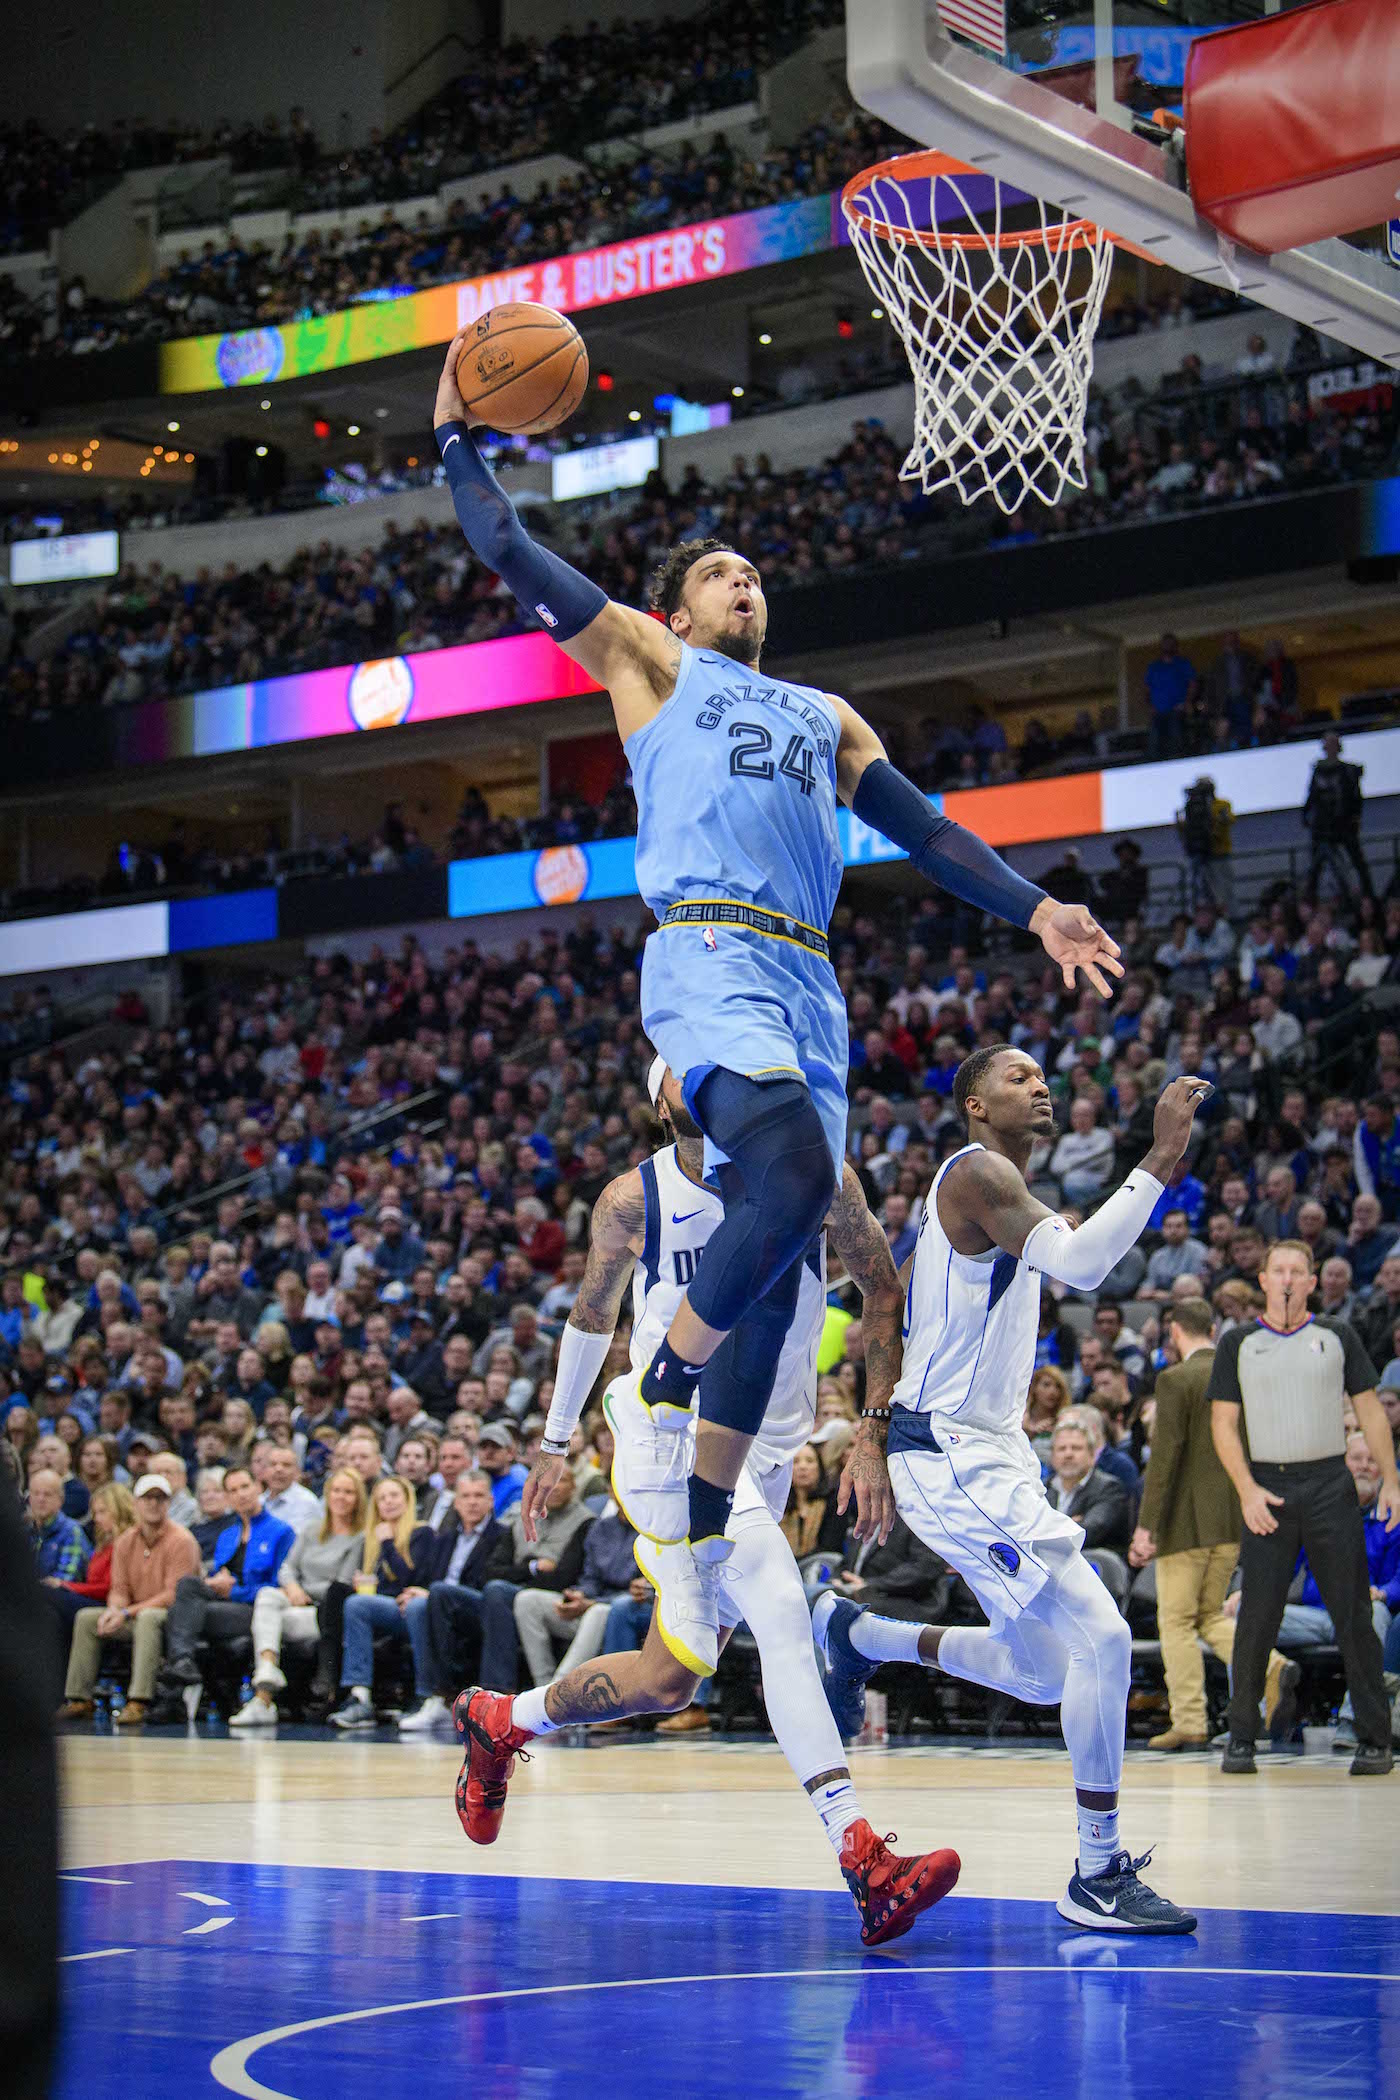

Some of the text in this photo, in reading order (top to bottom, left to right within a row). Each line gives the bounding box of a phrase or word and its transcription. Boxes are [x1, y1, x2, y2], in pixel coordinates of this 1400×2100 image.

[457, 224, 726, 331] DAVE & BUSTER'S
[695, 684, 831, 759] GRIZZLIES
[727, 721, 817, 797] 24
